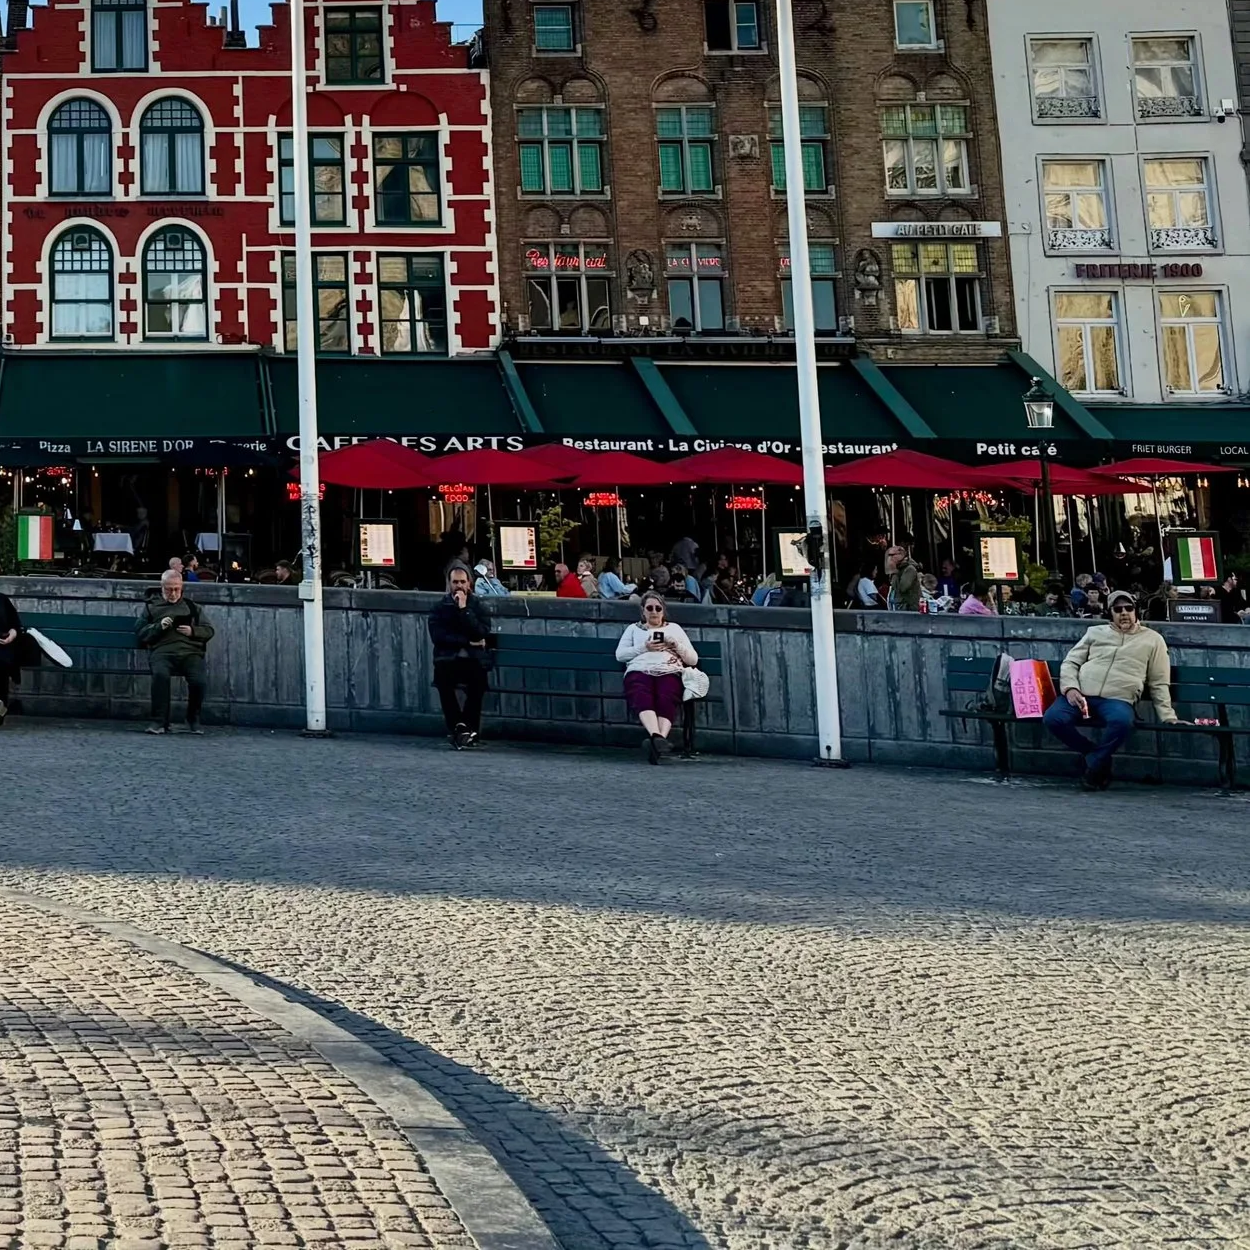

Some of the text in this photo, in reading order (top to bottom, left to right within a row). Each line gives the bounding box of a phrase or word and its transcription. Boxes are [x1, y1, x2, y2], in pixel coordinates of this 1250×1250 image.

[1075, 263, 1203, 279] FRITERIE 1900
[86, 441, 105, 453] LA
[109, 440, 158, 453] SIRENE
[443, 436, 524, 452] ARTS
[669, 438, 689, 452] La
[976, 442, 1058, 456] Petit caé
[1132, 444, 1192, 455] FRIET BURGER
[1220, 446, 1249, 455] LOCAL
[438, 484, 474, 494] BELGIAN
